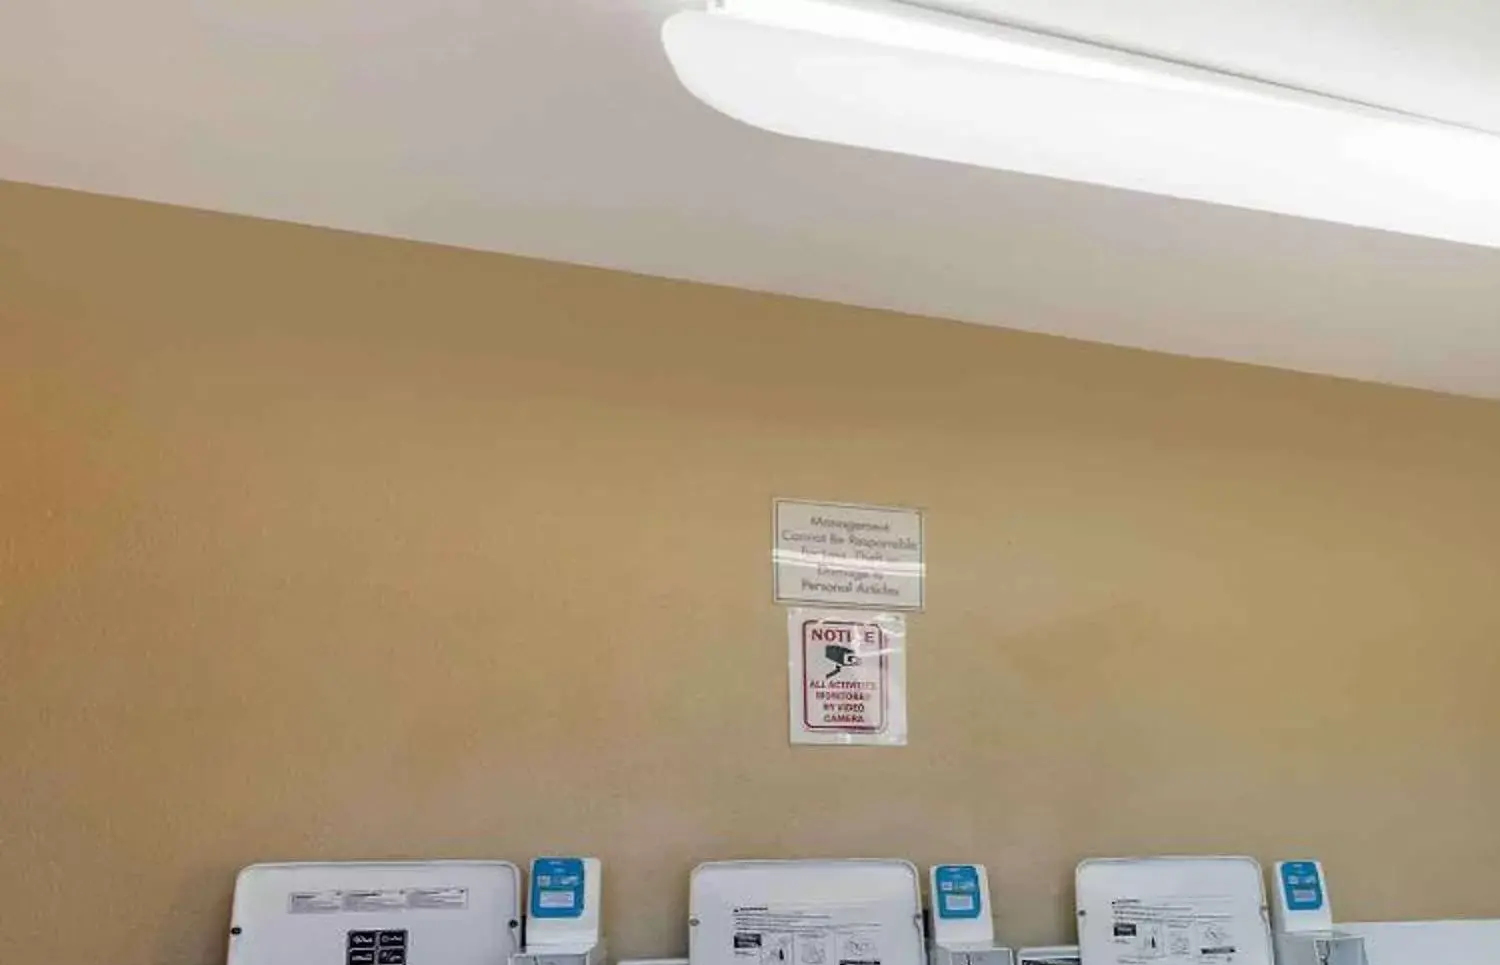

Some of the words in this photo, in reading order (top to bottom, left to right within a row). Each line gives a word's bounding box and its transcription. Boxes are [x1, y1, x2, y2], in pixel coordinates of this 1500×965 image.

[801, 578, 852, 593] Personal
[856, 583, 899, 595] Articles
[811, 628, 875, 643] NOTIE
[838, 703, 865, 712] VIDEO
[823, 714, 864, 723] CAMERA
